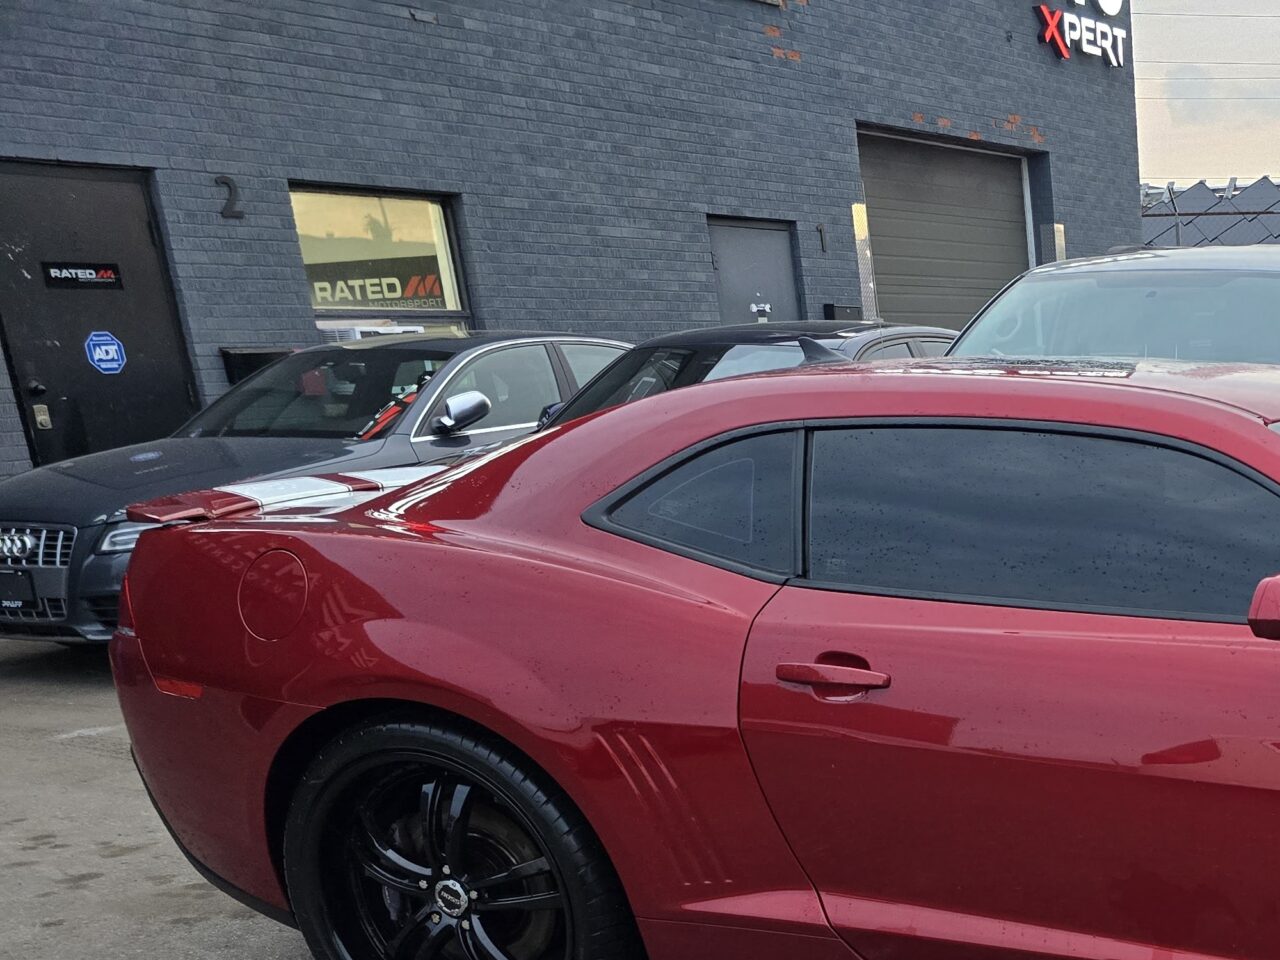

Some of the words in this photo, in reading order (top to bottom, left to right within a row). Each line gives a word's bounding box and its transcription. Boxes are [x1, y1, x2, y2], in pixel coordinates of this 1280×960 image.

[1039, 4, 1127, 67] XPERT
[214, 175, 244, 220] 2
[816, 223, 827, 252] 1
[49, 268, 97, 279] RATED
[313, 276, 403, 303] RATED
[95, 345, 119, 360] ADT
